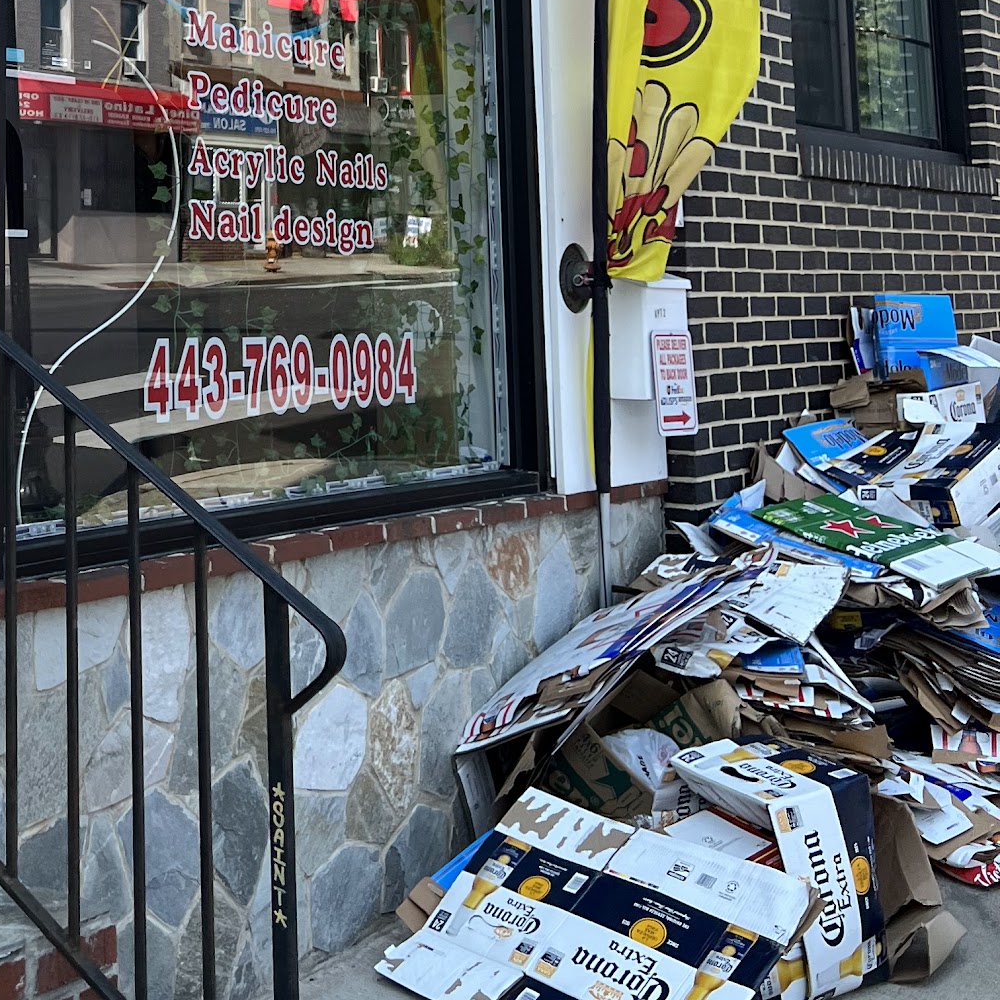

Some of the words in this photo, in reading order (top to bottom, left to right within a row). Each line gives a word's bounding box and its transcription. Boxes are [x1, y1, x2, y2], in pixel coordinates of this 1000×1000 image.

[186, 7, 345, 70] Manicure
[187, 71, 337, 127] Pedicure
[188, 137, 304, 188] Acrylic
[316, 149, 388, 190] Nails
[188, 200, 263, 243] Nail
[271, 205, 375, 255] design
[144, 331, 417, 423] 443-769-0984
[273, 801, 287, 906] SAINT
[507, 898, 536, 917] Extra
[804, 830, 845, 946] Corona
[833, 853, 852, 911] Extra
[483, 902, 541, 934] Corona
[571, 947, 670, 1000] Corona
[609, 940, 658, 975] Extra
